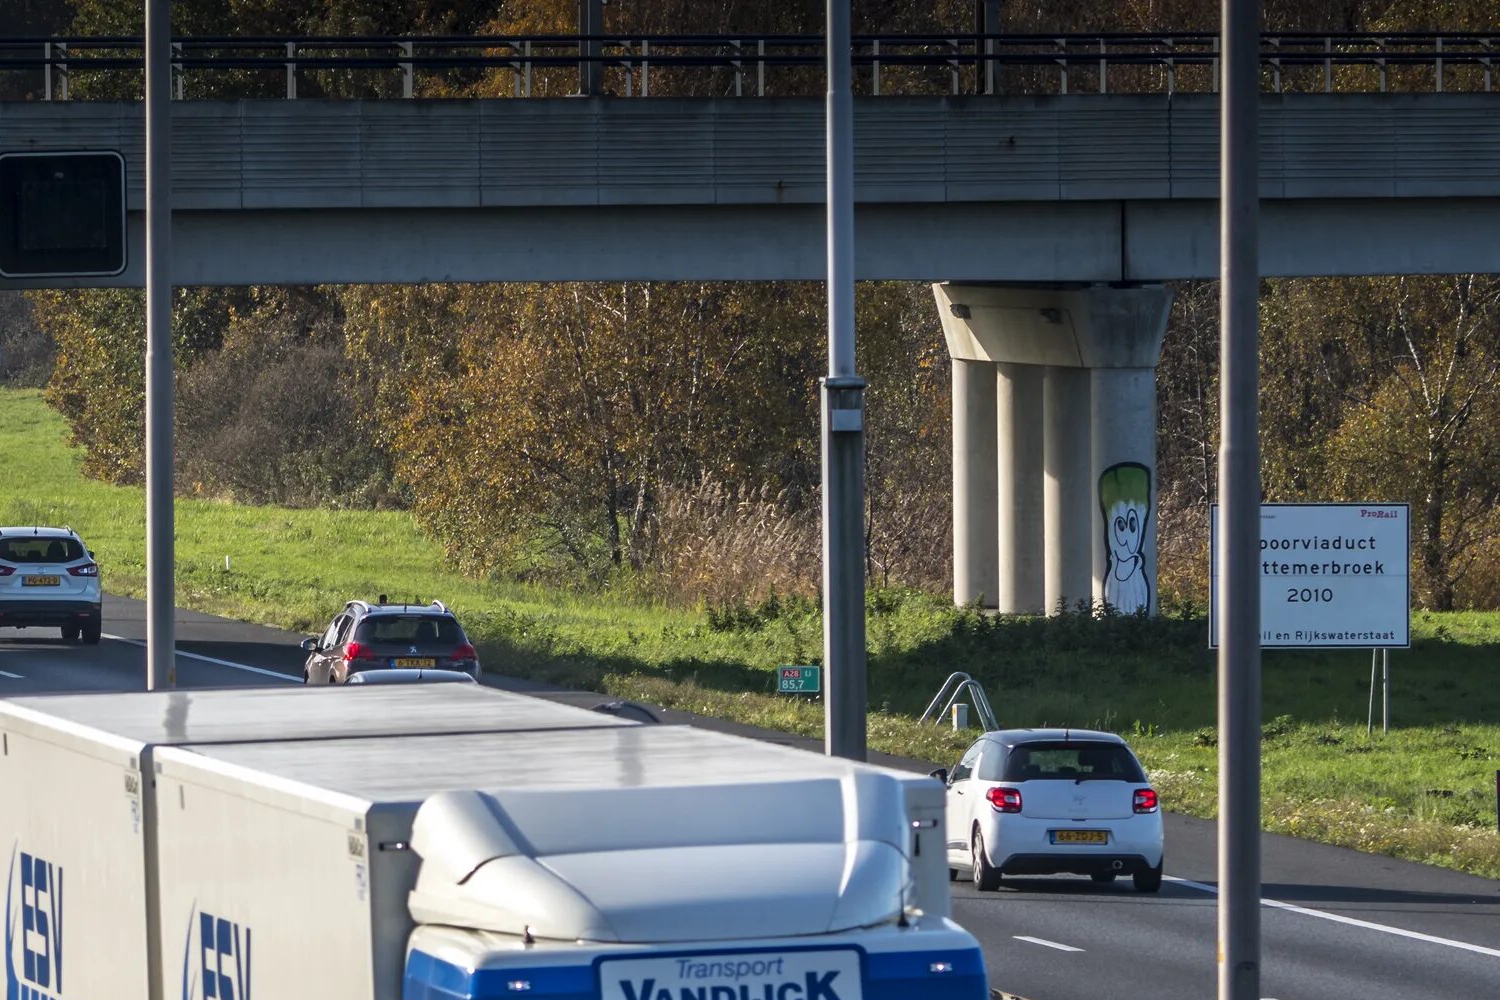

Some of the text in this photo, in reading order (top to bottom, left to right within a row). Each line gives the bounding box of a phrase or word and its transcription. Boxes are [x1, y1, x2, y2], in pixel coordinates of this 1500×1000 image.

[1360, 509, 1398, 519] ProRail
[1260, 536, 1376, 551] poorviaduct
[1262, 560, 1385, 575] ttemerbroek
[1287, 588, 1334, 603] 2010
[1295, 631, 1395, 642] Rijkswaterstaat
[782, 680, 805, 690] 85,7
[20, 852, 63, 996] ESV
[675, 957, 785, 981] Transport
